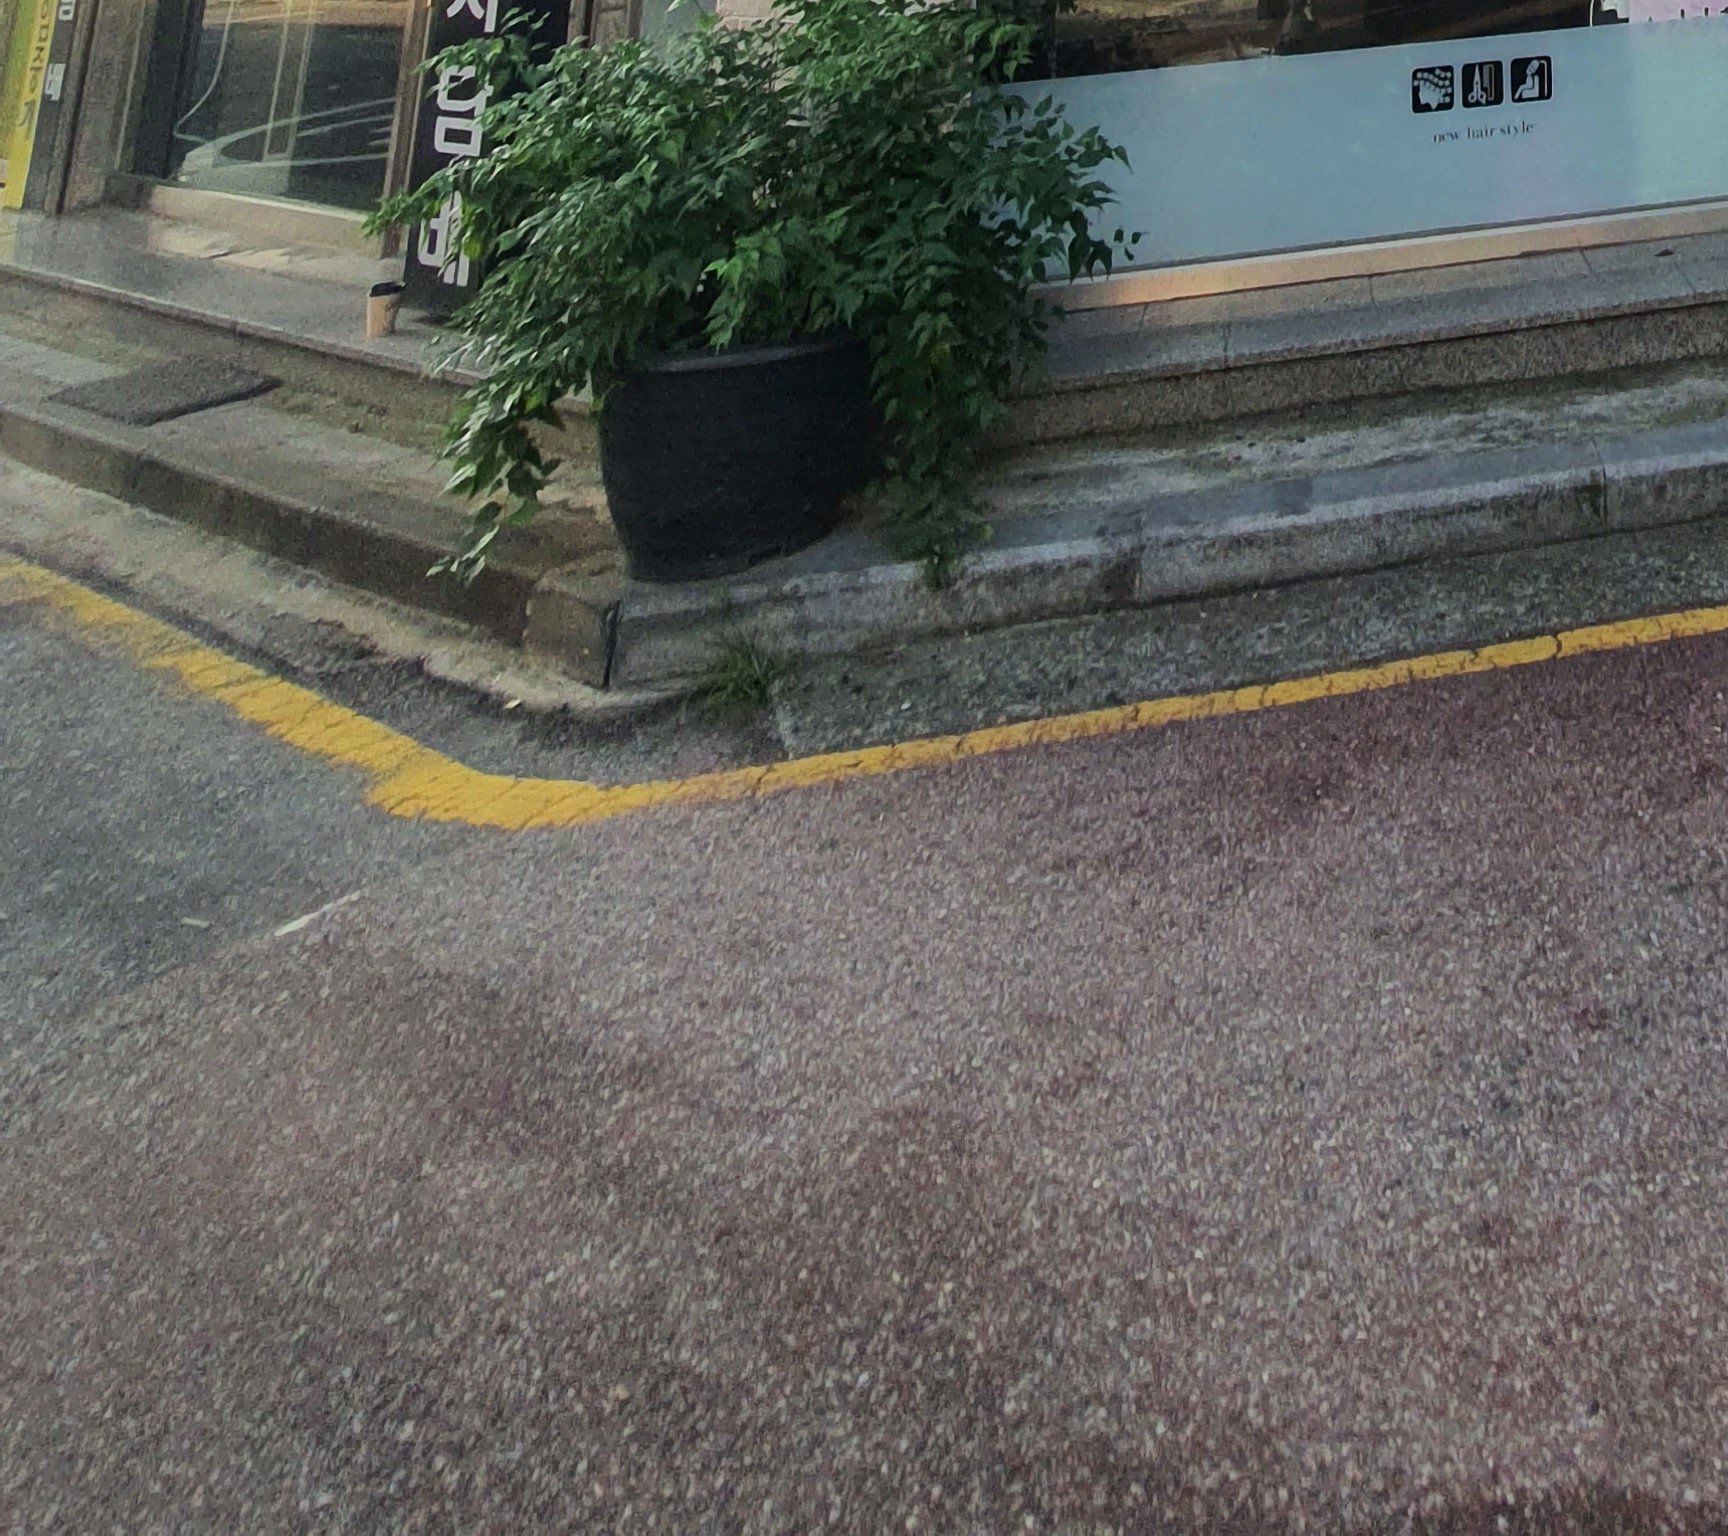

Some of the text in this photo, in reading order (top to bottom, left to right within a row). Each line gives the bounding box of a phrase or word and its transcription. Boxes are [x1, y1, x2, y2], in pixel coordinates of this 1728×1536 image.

[1433, 120, 1534, 144] new hair style
